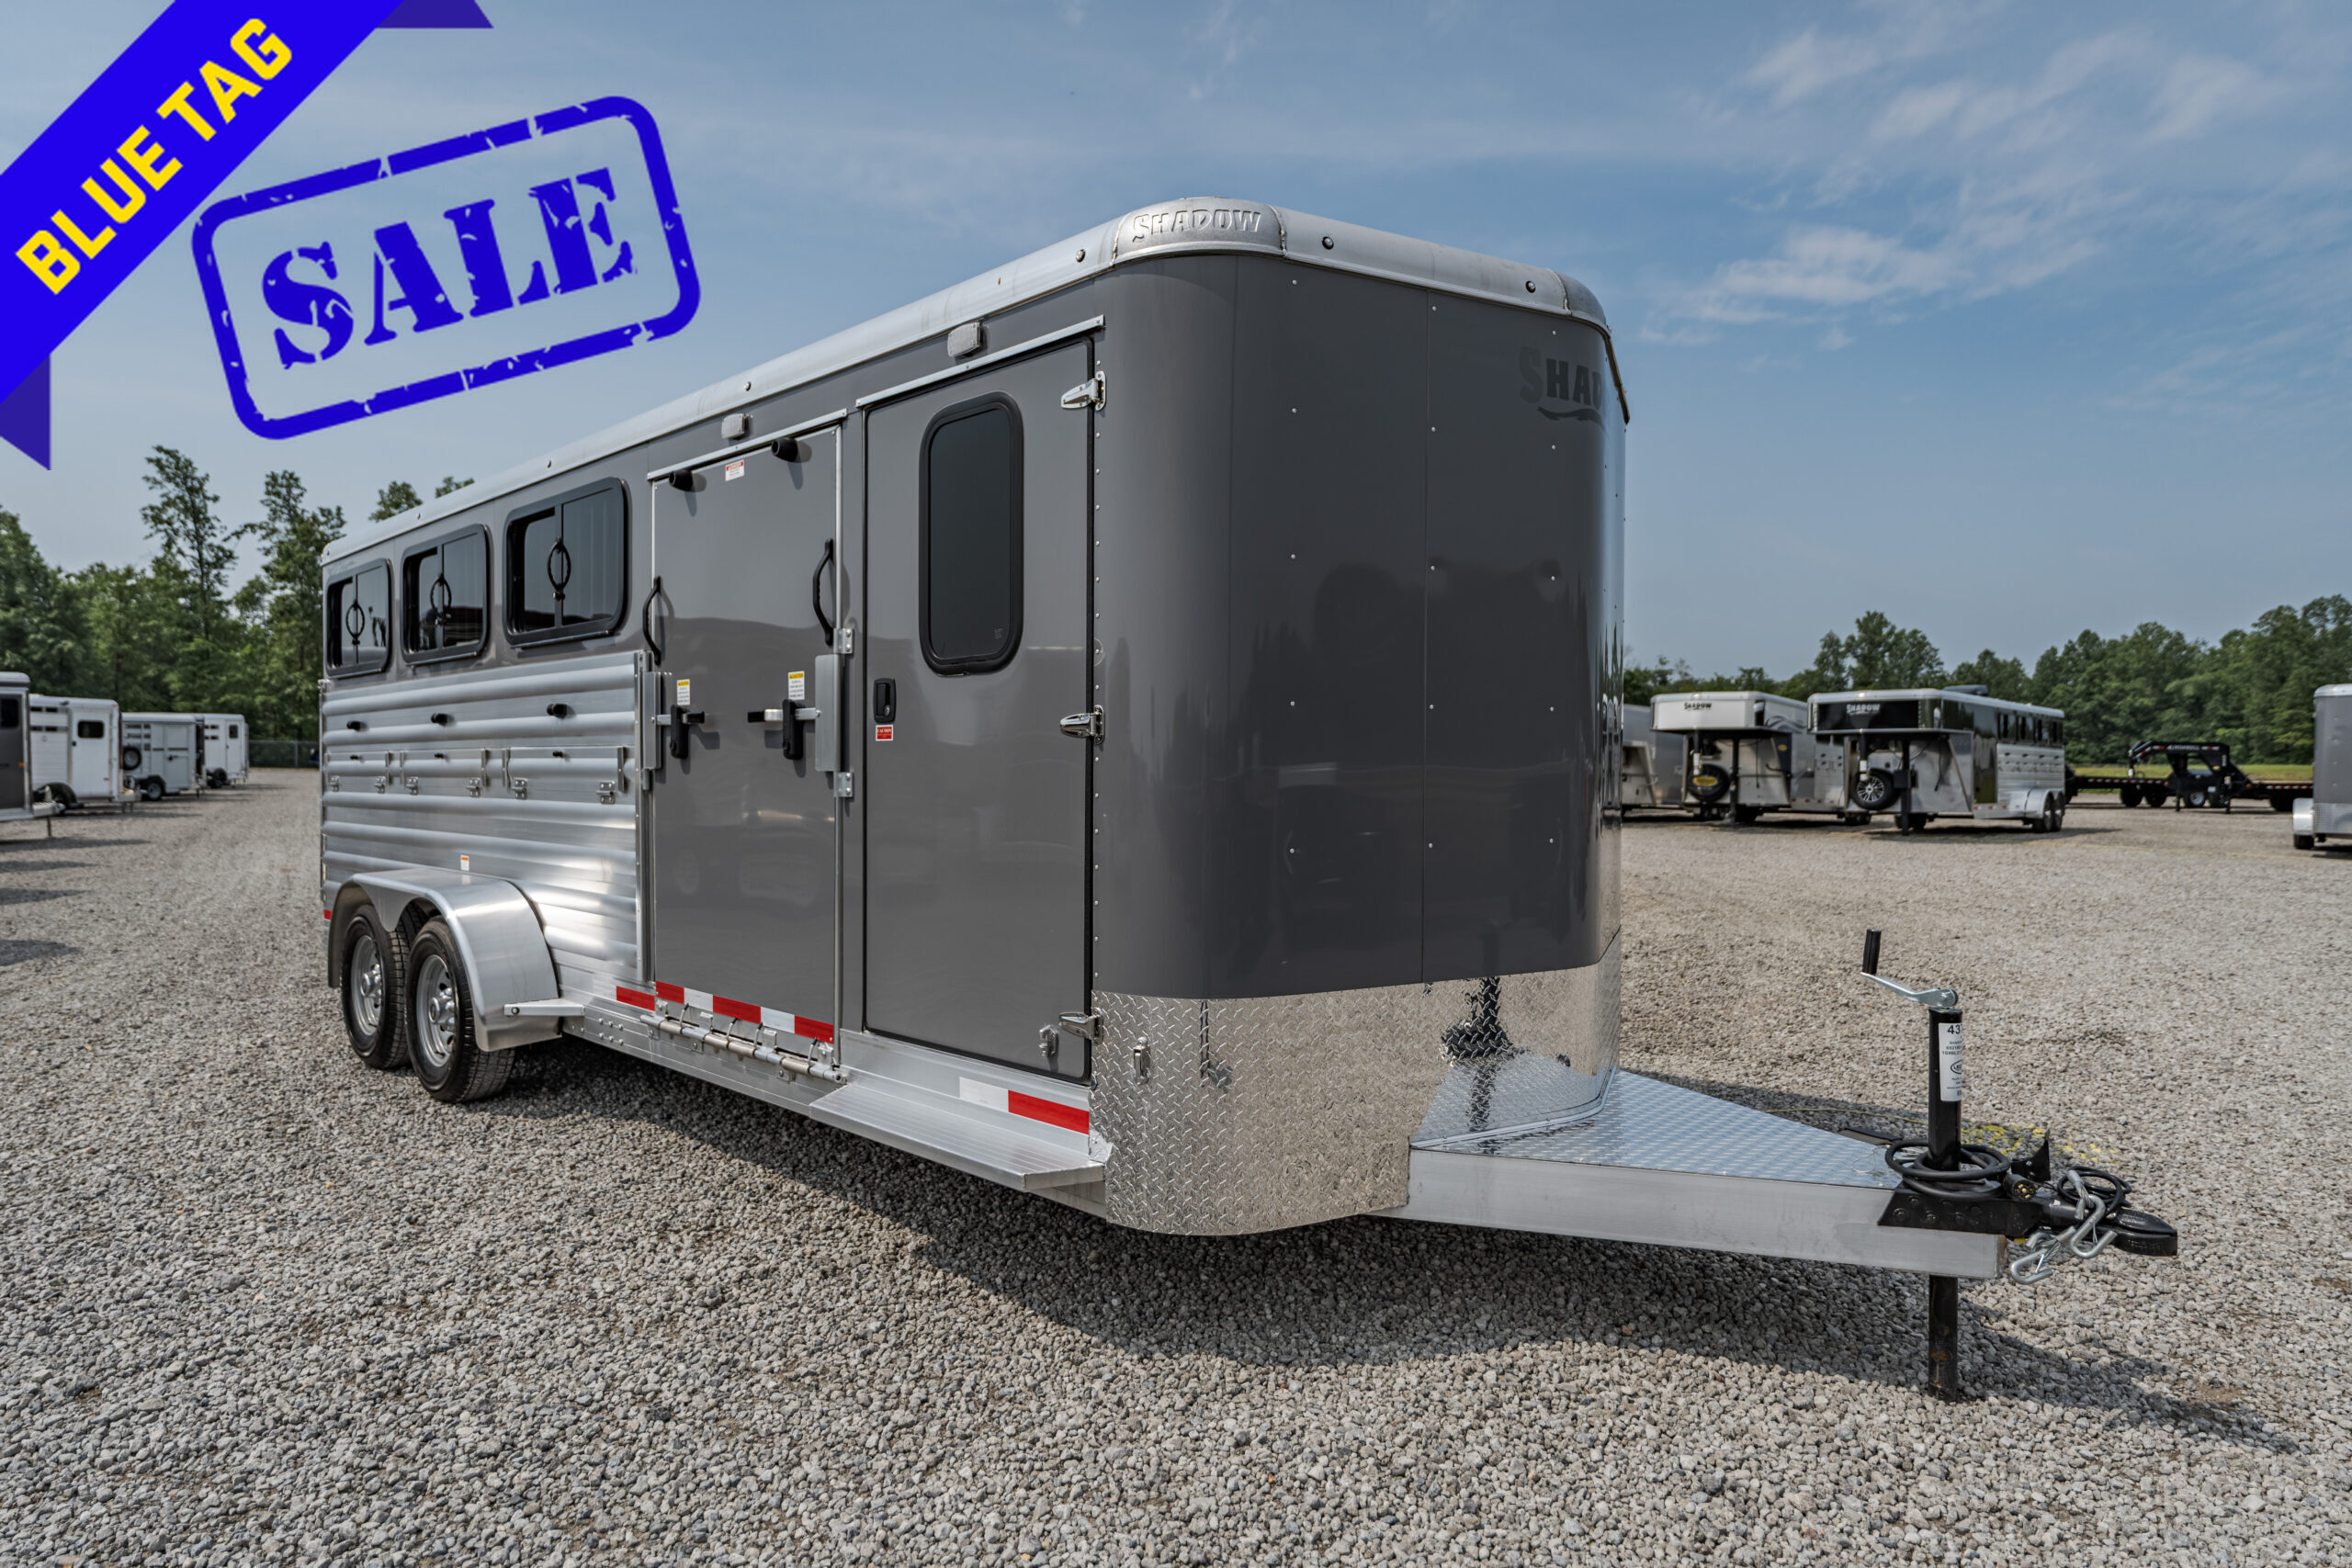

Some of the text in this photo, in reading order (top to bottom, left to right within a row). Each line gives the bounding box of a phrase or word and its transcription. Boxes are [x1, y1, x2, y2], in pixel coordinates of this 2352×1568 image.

[1132, 209, 1261, 243] SHADOW
[1684, 702, 1712, 710] SHADOW
[1846, 704, 1881, 714] SHADOW
